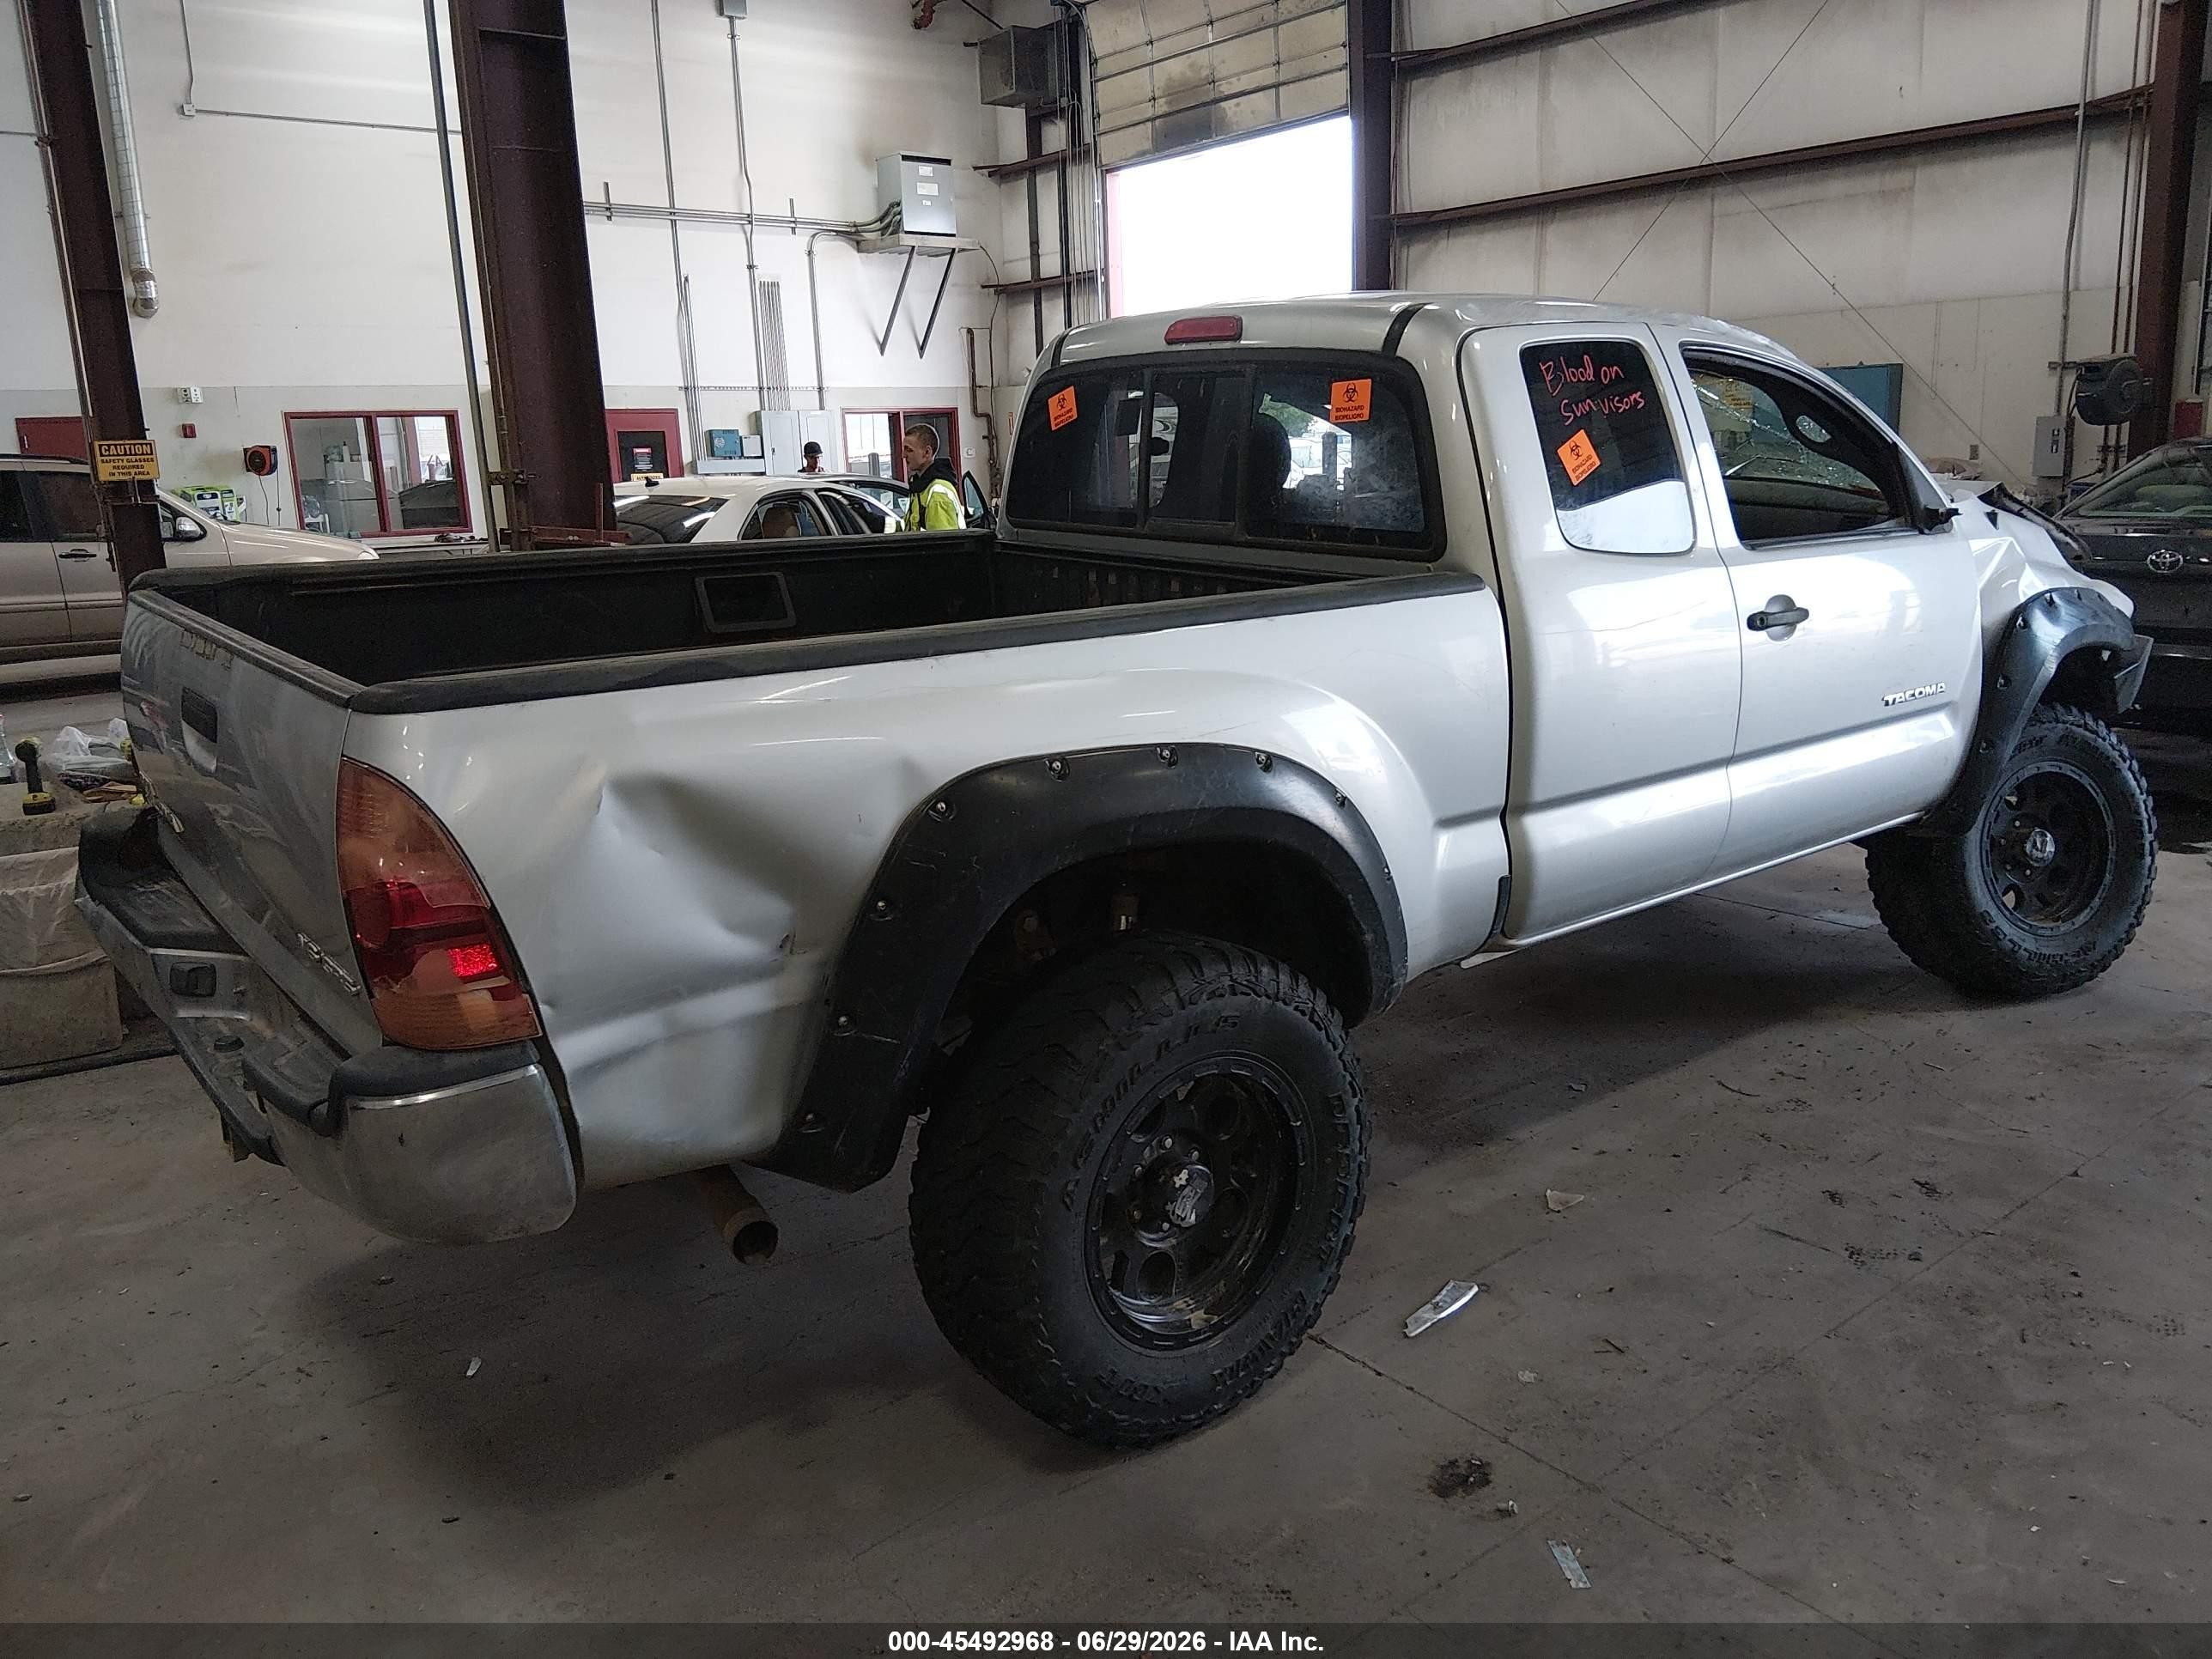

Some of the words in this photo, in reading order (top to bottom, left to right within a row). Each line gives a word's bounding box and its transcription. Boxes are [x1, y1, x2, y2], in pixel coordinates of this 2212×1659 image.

[1539, 355, 1595, 396] Blood
[1601, 366, 1625, 384] on
[101, 444, 152, 455] CAUTION
[1881, 682, 1946, 706] TACOMA
